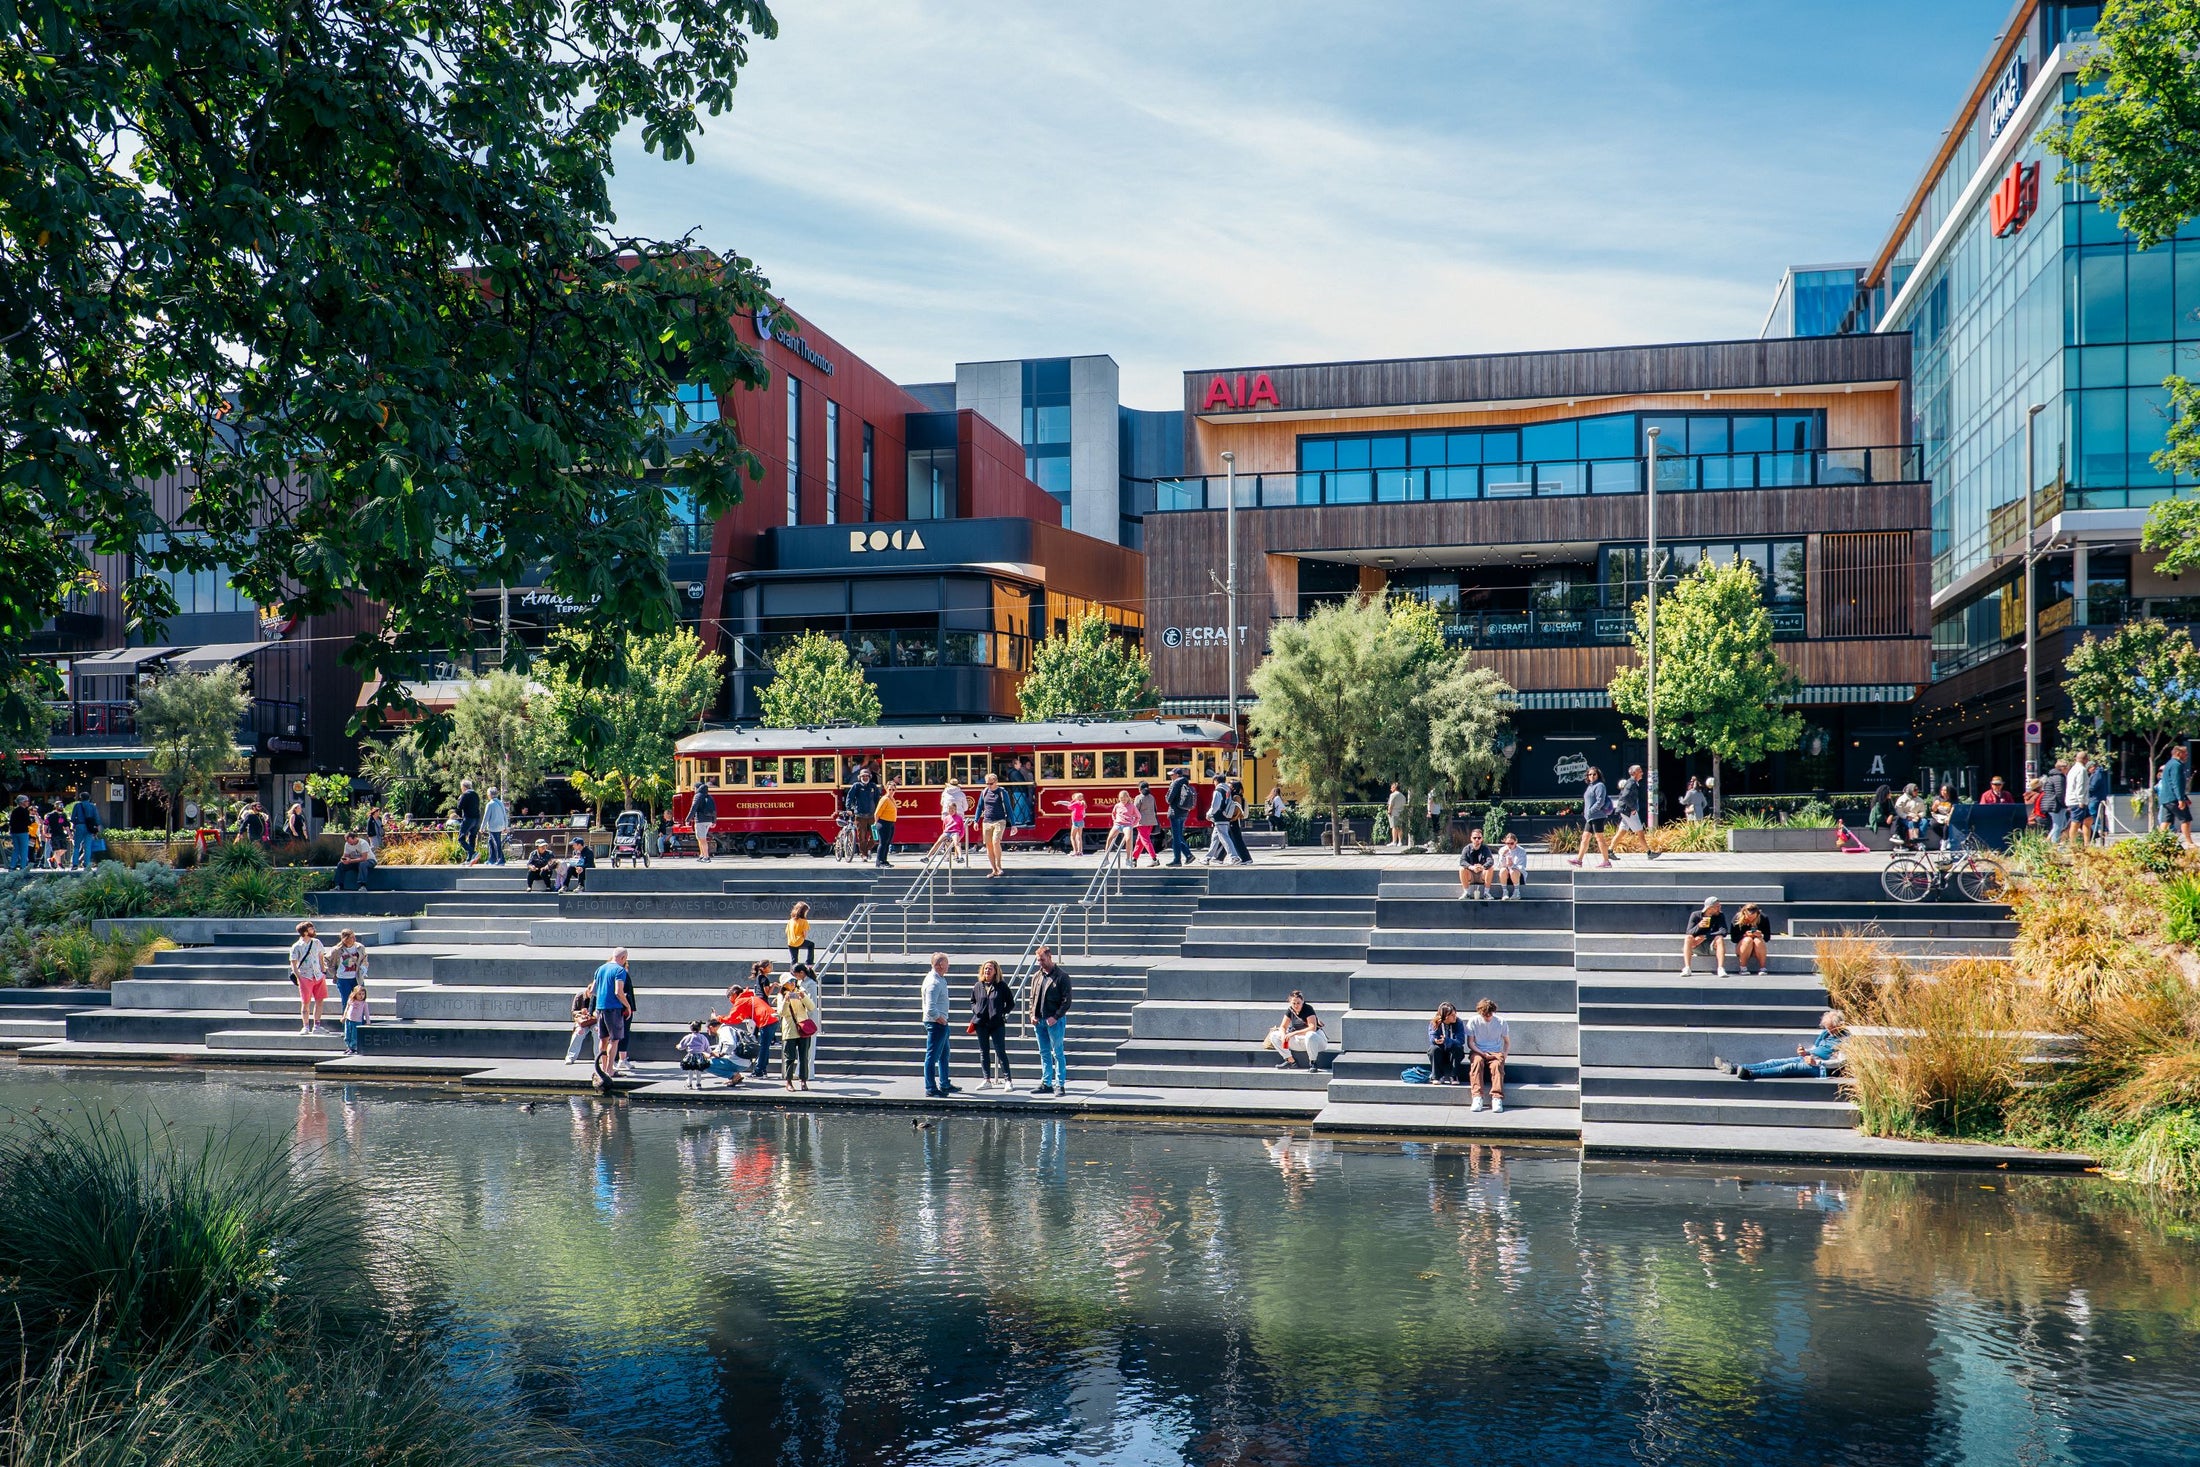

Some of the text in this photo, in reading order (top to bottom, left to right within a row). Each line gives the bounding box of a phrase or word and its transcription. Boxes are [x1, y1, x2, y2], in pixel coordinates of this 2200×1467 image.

[799, 336, 835, 377] Thornton
[1203, 374, 1280, 409] AIA
[850, 529, 925, 552] ROCA
[1192, 626, 1248, 640] CRAT
[1185, 639, 1246, 647] EMBASY
[1869, 754, 1886, 775] A
[895, 800, 919, 809] 244
[565, 901, 839, 912] A FLOTILLA OF LEAVES FLOATS DOWNEAM
[536, 928, 578, 939] ALONG
[582, 928, 607, 939] THE
[611, 929, 638, 939] INKY
[643, 929, 682, 939] BLACK
[688, 929, 729, 939] WATER
[733, 929, 749, 939] OF
[754, 929, 776, 939] THE
[402, 998, 556, 1012] AND INTO THEIR FUTURE
[364, 1034, 438, 1047] BEHIND ME
